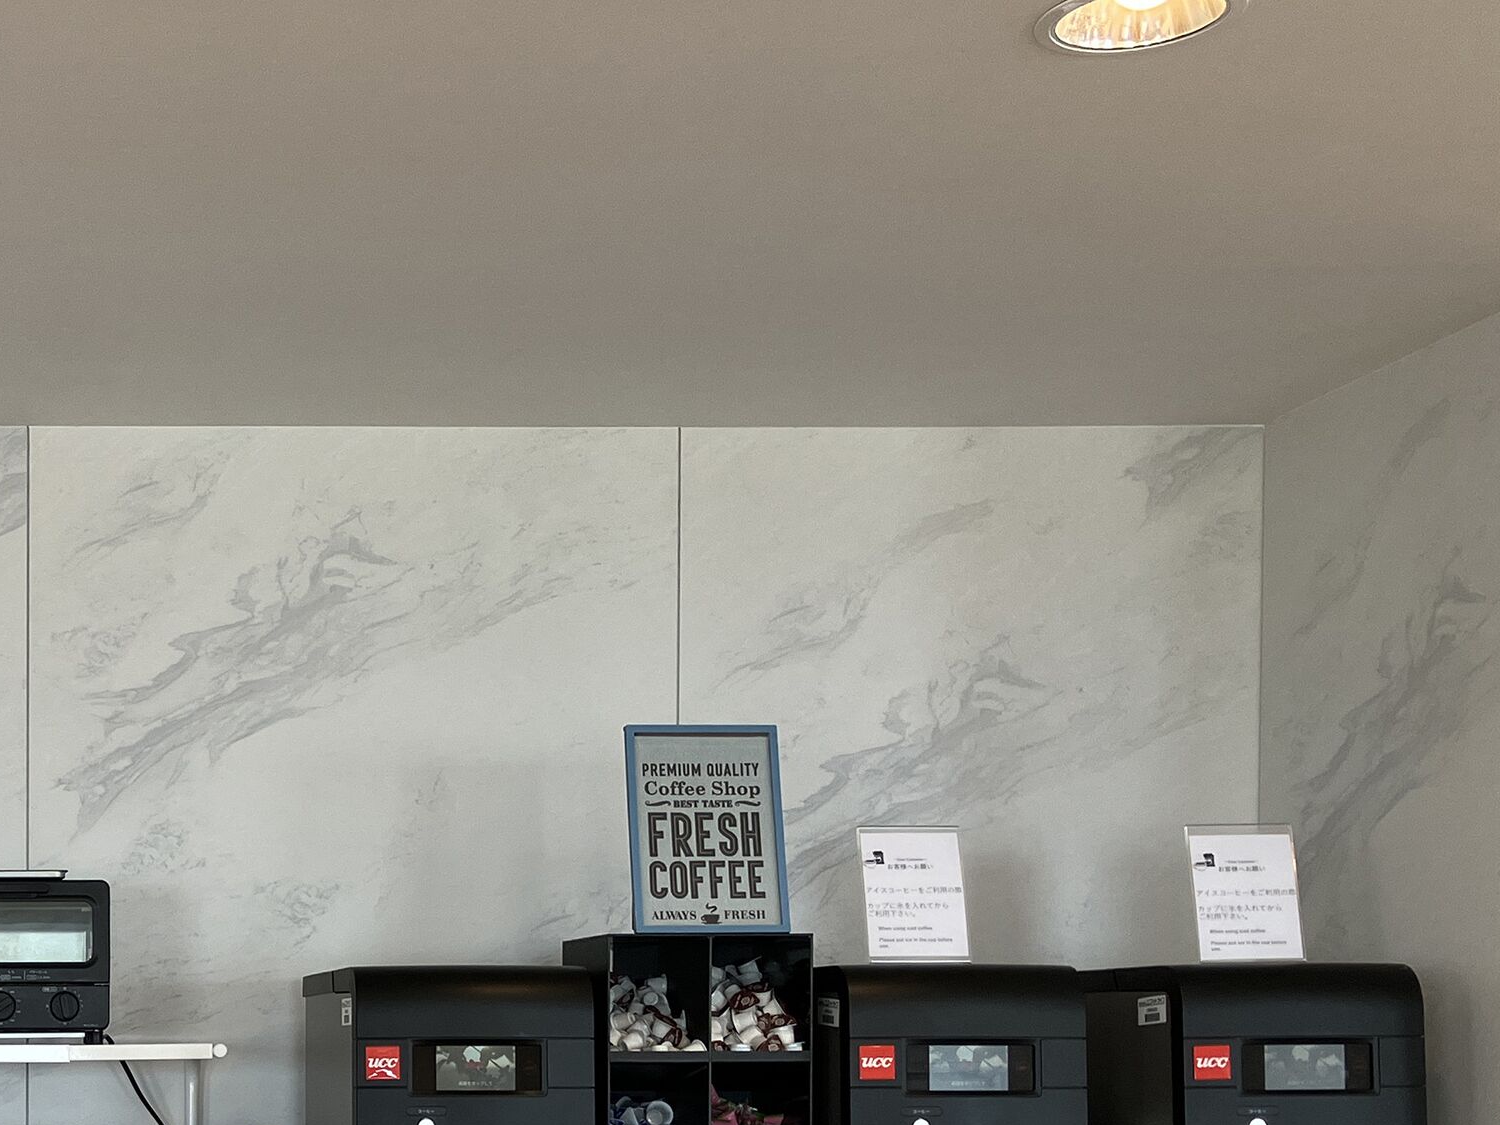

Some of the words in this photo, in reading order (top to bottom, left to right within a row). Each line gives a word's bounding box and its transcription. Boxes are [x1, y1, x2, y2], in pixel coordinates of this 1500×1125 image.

[642, 762, 701, 777] PREMIUM
[706, 762, 759, 777] QUALITY
[644, 780, 706, 796] Coffee
[711, 780, 761, 799] Shop
[673, 800, 699, 808] BEST
[701, 800, 733, 808] TASTE
[647, 811, 763, 858] FRESH
[649, 860, 766, 899] COFFEE
[651, 910, 697, 921] ALWAYS
[723, 910, 766, 920] FRESH
